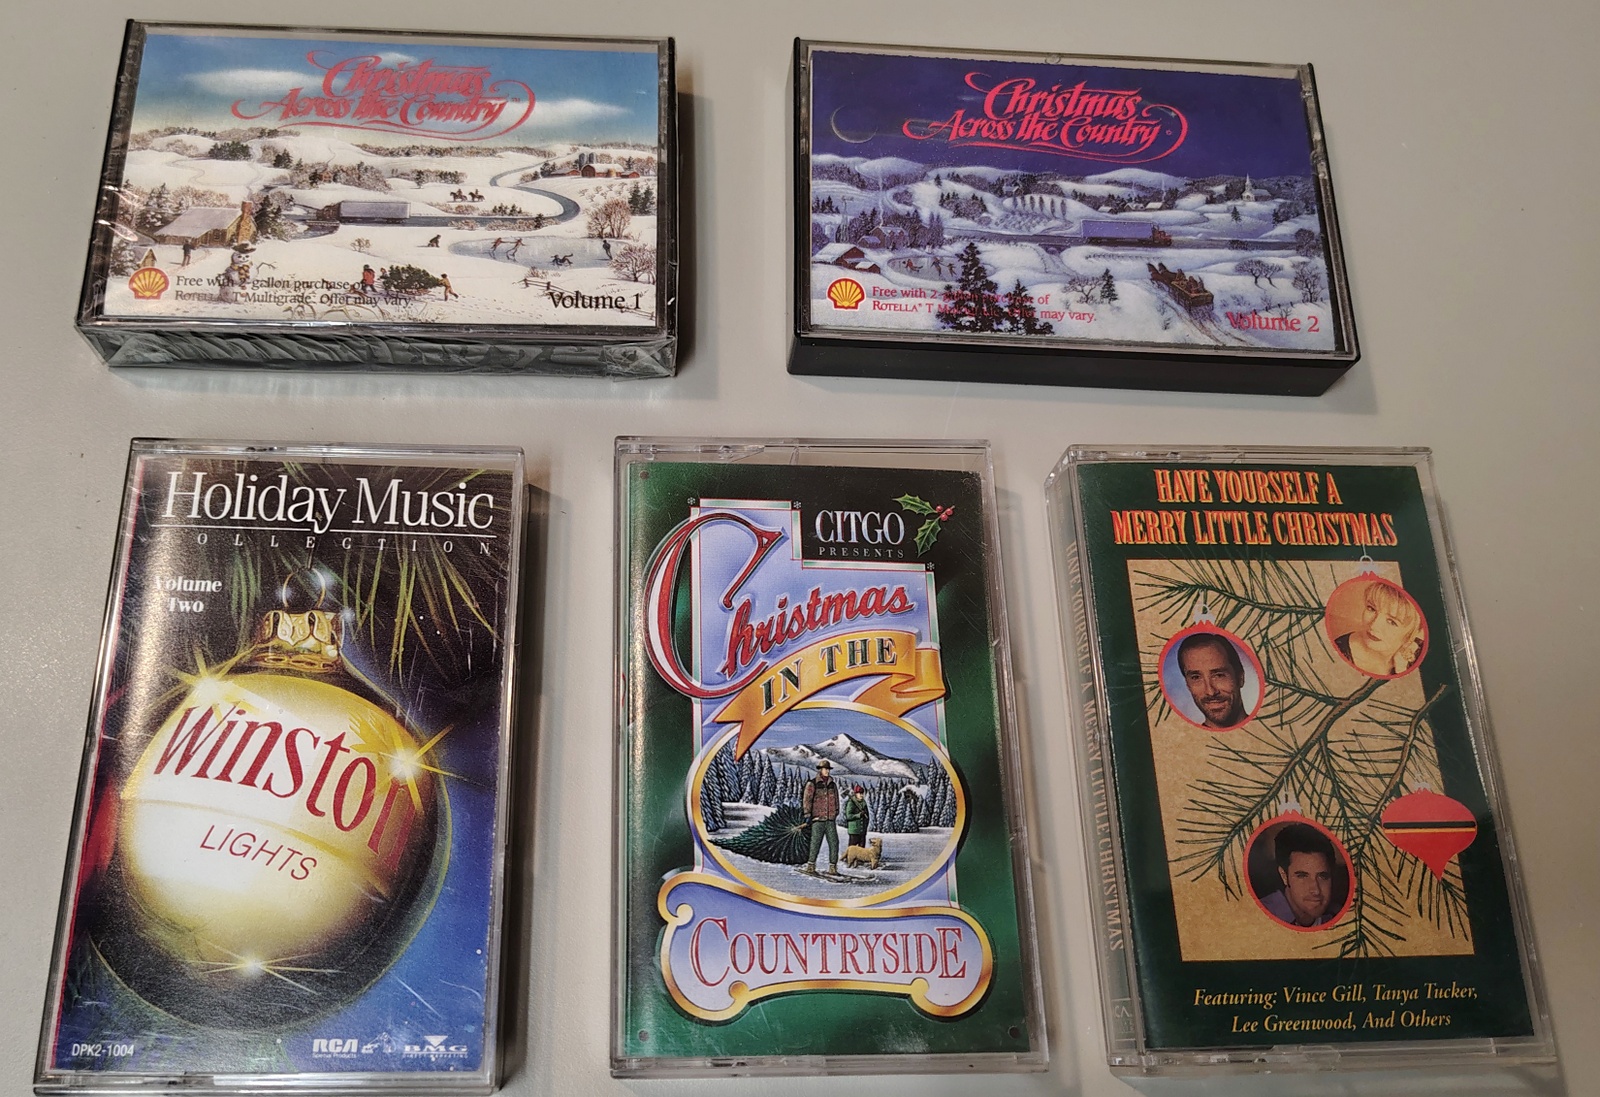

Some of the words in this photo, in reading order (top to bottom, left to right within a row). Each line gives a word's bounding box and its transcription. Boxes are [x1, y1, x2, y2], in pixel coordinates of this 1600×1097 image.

[307, 50, 492, 98] Christmas
[231, 86, 352, 121] Across
[351, 89, 398, 121] the
[399, 92, 512, 134] Country
[964, 71, 1142, 120] Christmas
[902, 109, 1015, 141] Across
[1015, 111, 1060, 141] the
[1060, 114, 1166, 156] Country
[175, 275, 203, 287] Free
[207, 273, 234, 287] with
[294, 278, 350, 291] purchase
[232, 291, 240, 302] T
[320, 293, 352, 305] Offer
[357, 296, 380, 307] may
[549, 290, 625, 310] Volume
[633, 293, 642, 310] 1
[872, 286, 897, 297] Free
[900, 287, 926, 299] with
[1037, 294, 1050, 305] of
[925, 303, 934, 313] T
[1040, 310, 1064, 322] may
[1068, 312, 1097, 324] vary.
[1225, 310, 1301, 332] Volume
[1307, 315, 1320, 333] 2
[161, 471, 347, 534] Holiday
[352, 477, 495, 529] Music
[1153, 468, 1213, 503] HAVE
[1212, 469, 1320, 504] YOURSELF
[1325, 472, 1343, 505] A
[160, 531, 492, 556] OLLECTION
[814, 509, 905, 545] CITGO
[1110, 510, 1188, 545] MERRY
[1191, 510, 1272, 545] LITTLE
[1272, 510, 1399, 547] CHRISTMAS
[818, 546, 904, 559] PRESENTS
[1065, 540, 1082, 589] HAVE
[643, 511, 914, 699] Christmas
[1070, 588, 1093, 676] YOURSELF
[760, 658, 802, 715] IN
[820, 636, 898, 677] THE
[1081, 678, 1093, 694] A
[1083, 699, 1103, 762] MERRY
[153, 701, 417, 872] Winston
[1090, 766, 1111, 833] LITTLE
[199, 824, 318, 881] LIGHTS
[1098, 835, 1124, 952] CHRISTMAS
[690, 916, 967, 987] COUNTRYSIDE
[1193, 988, 1278, 1010] Featuring:
[1282, 985, 1327, 1004] Vince
[1331, 983, 1367, 1003] Gill,
[1372, 983, 1419, 1006] Tanya
[1423, 980, 1479, 1000] Tucker,
[1231, 1015, 1258, 1033] Lee
[1263, 1010, 1357, 1032] Greenwood,
[1361, 1010, 1396, 1029] And
[1400, 1008, 1452, 1027] Others
[71, 1043, 135, 1057] DPK2-1004
[312, 1038, 358, 1053] RCA
[404, 1044, 468, 1052] BMG
